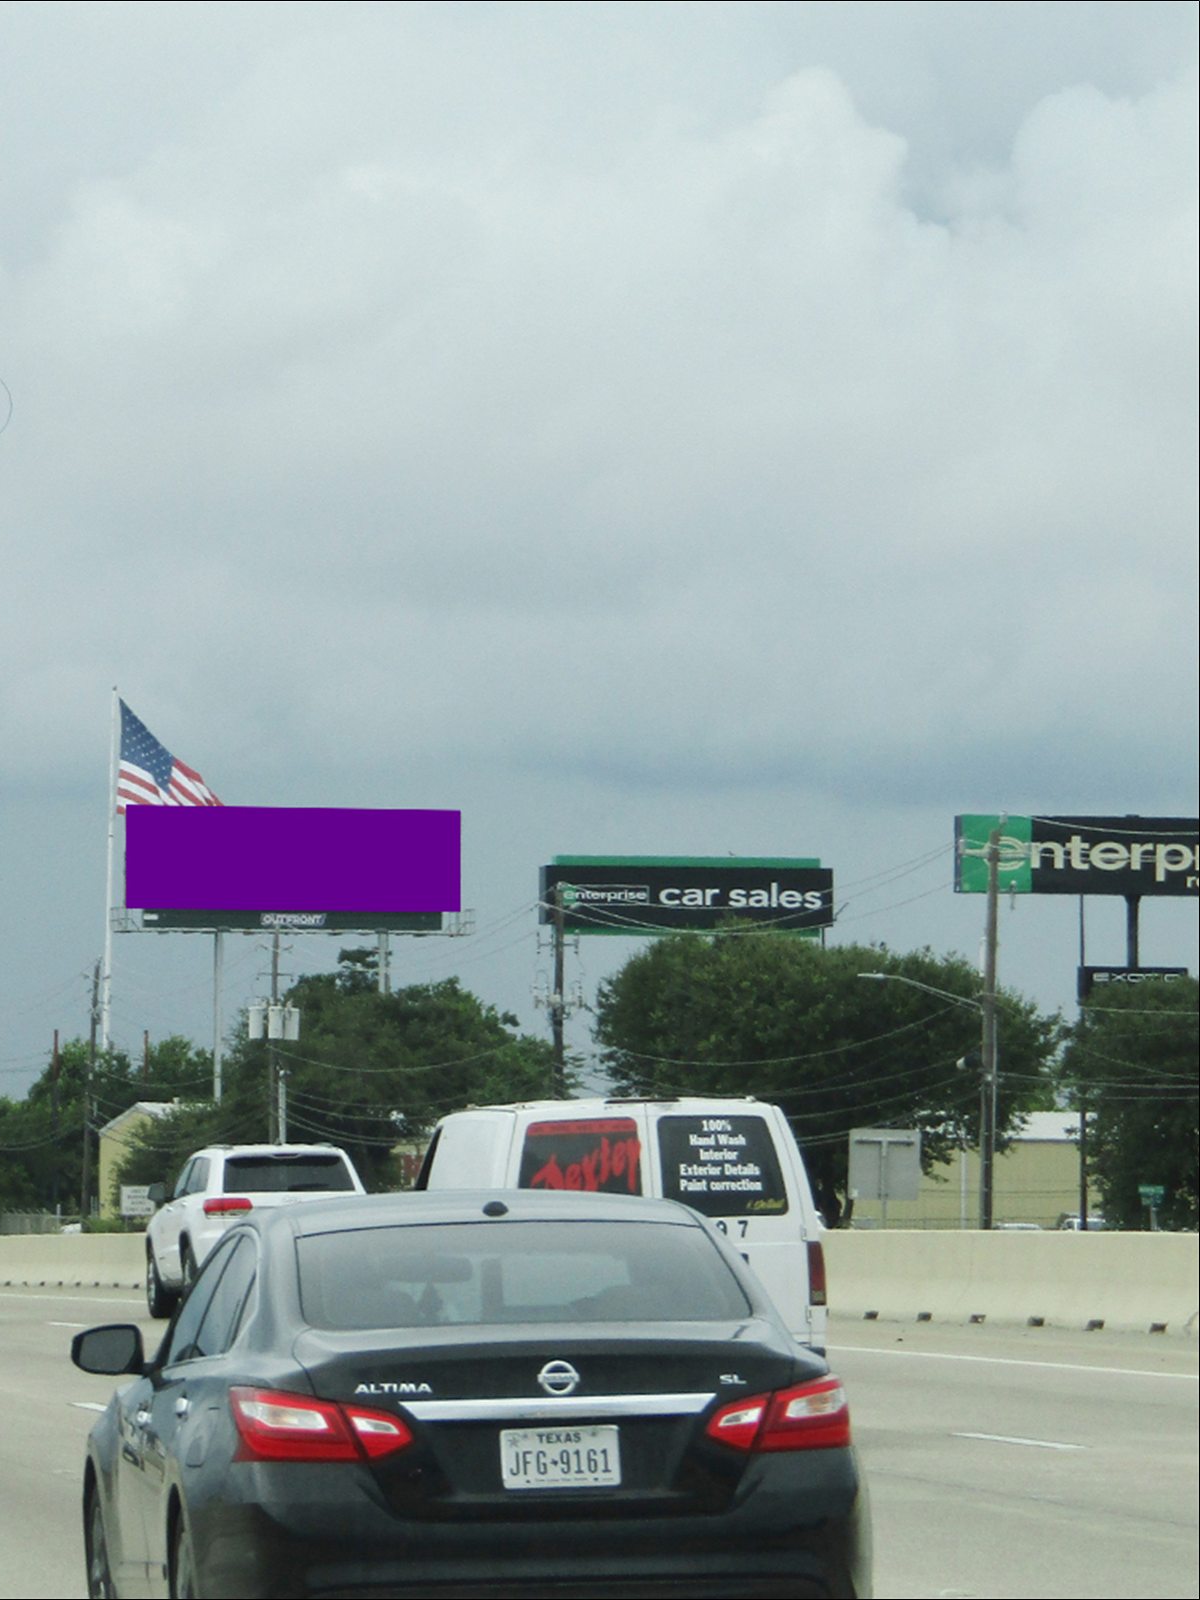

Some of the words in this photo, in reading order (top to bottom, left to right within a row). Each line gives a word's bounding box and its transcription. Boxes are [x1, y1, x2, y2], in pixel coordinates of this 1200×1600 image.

[983, 835, 1199, 882] enterp
[563, 889, 647, 901] enterprise
[659, 887, 720, 906] car
[729, 883, 822, 909] sales
[262, 913, 322, 925] OUTFRONT
[1093, 972, 1179, 983] EXOTC
[702, 1120, 732, 1132] 100%
[689, 1134, 716, 1146] Hand
[717, 1134, 746, 1146] Wash
[700, 1148, 739, 1160] Interior
[680, 1163, 722, 1176] Exterior
[724, 1163, 761, 1176] Details
[680, 1178, 708, 1191] Paint
[709, 1179, 763, 1191] correction
[719, 1375, 747, 1385] SL
[354, 1383, 433, 1395] ALTIMA
[536, 1432, 582, 1444] TEXAS
